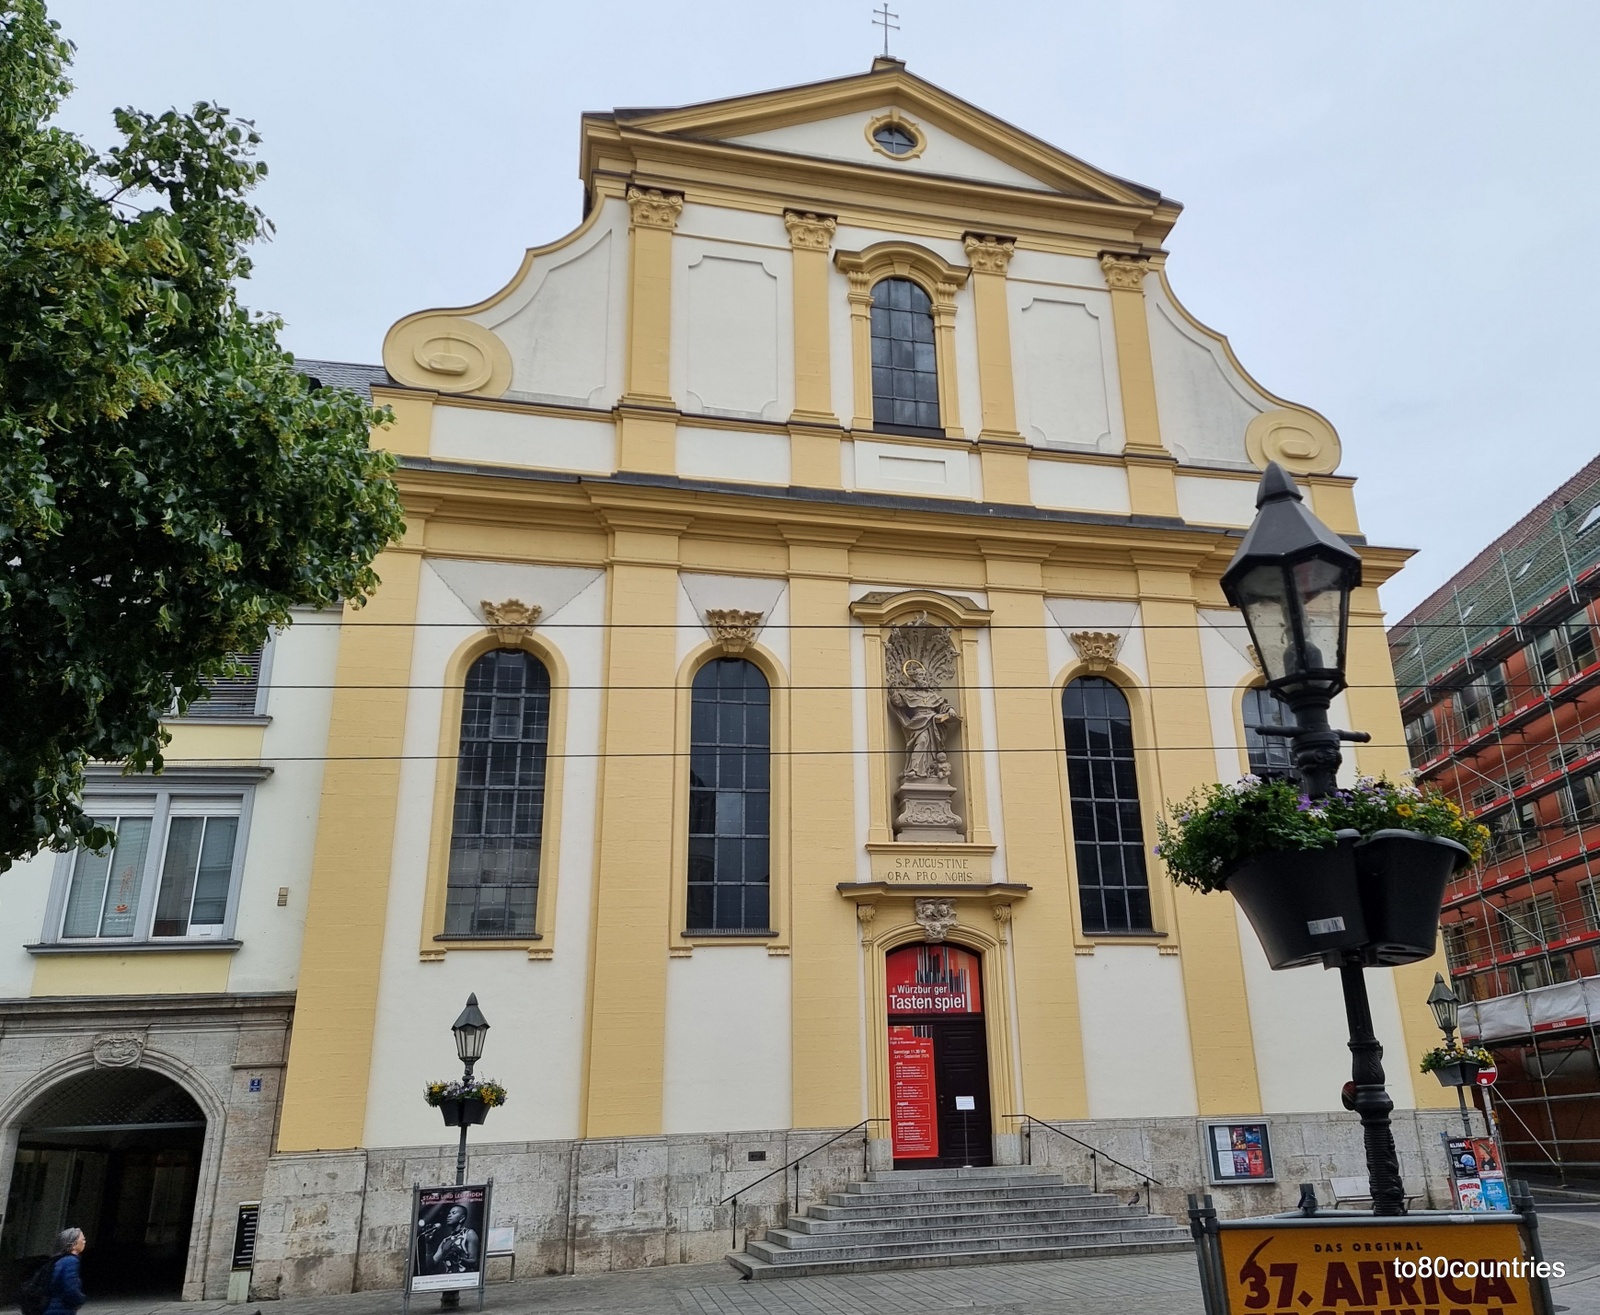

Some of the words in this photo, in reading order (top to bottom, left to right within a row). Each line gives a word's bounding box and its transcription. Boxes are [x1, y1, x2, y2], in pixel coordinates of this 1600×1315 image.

[887, 871, 911, 881] ORA
[916, 871, 938, 881] PRO
[1314, 1243, 1343, 1252] DAS
[1352, 1241, 1424, 1251] ORGINAL
[1240, 1246, 1314, 1309] 37.
[1322, 1258, 1518, 1308] AFRICA
